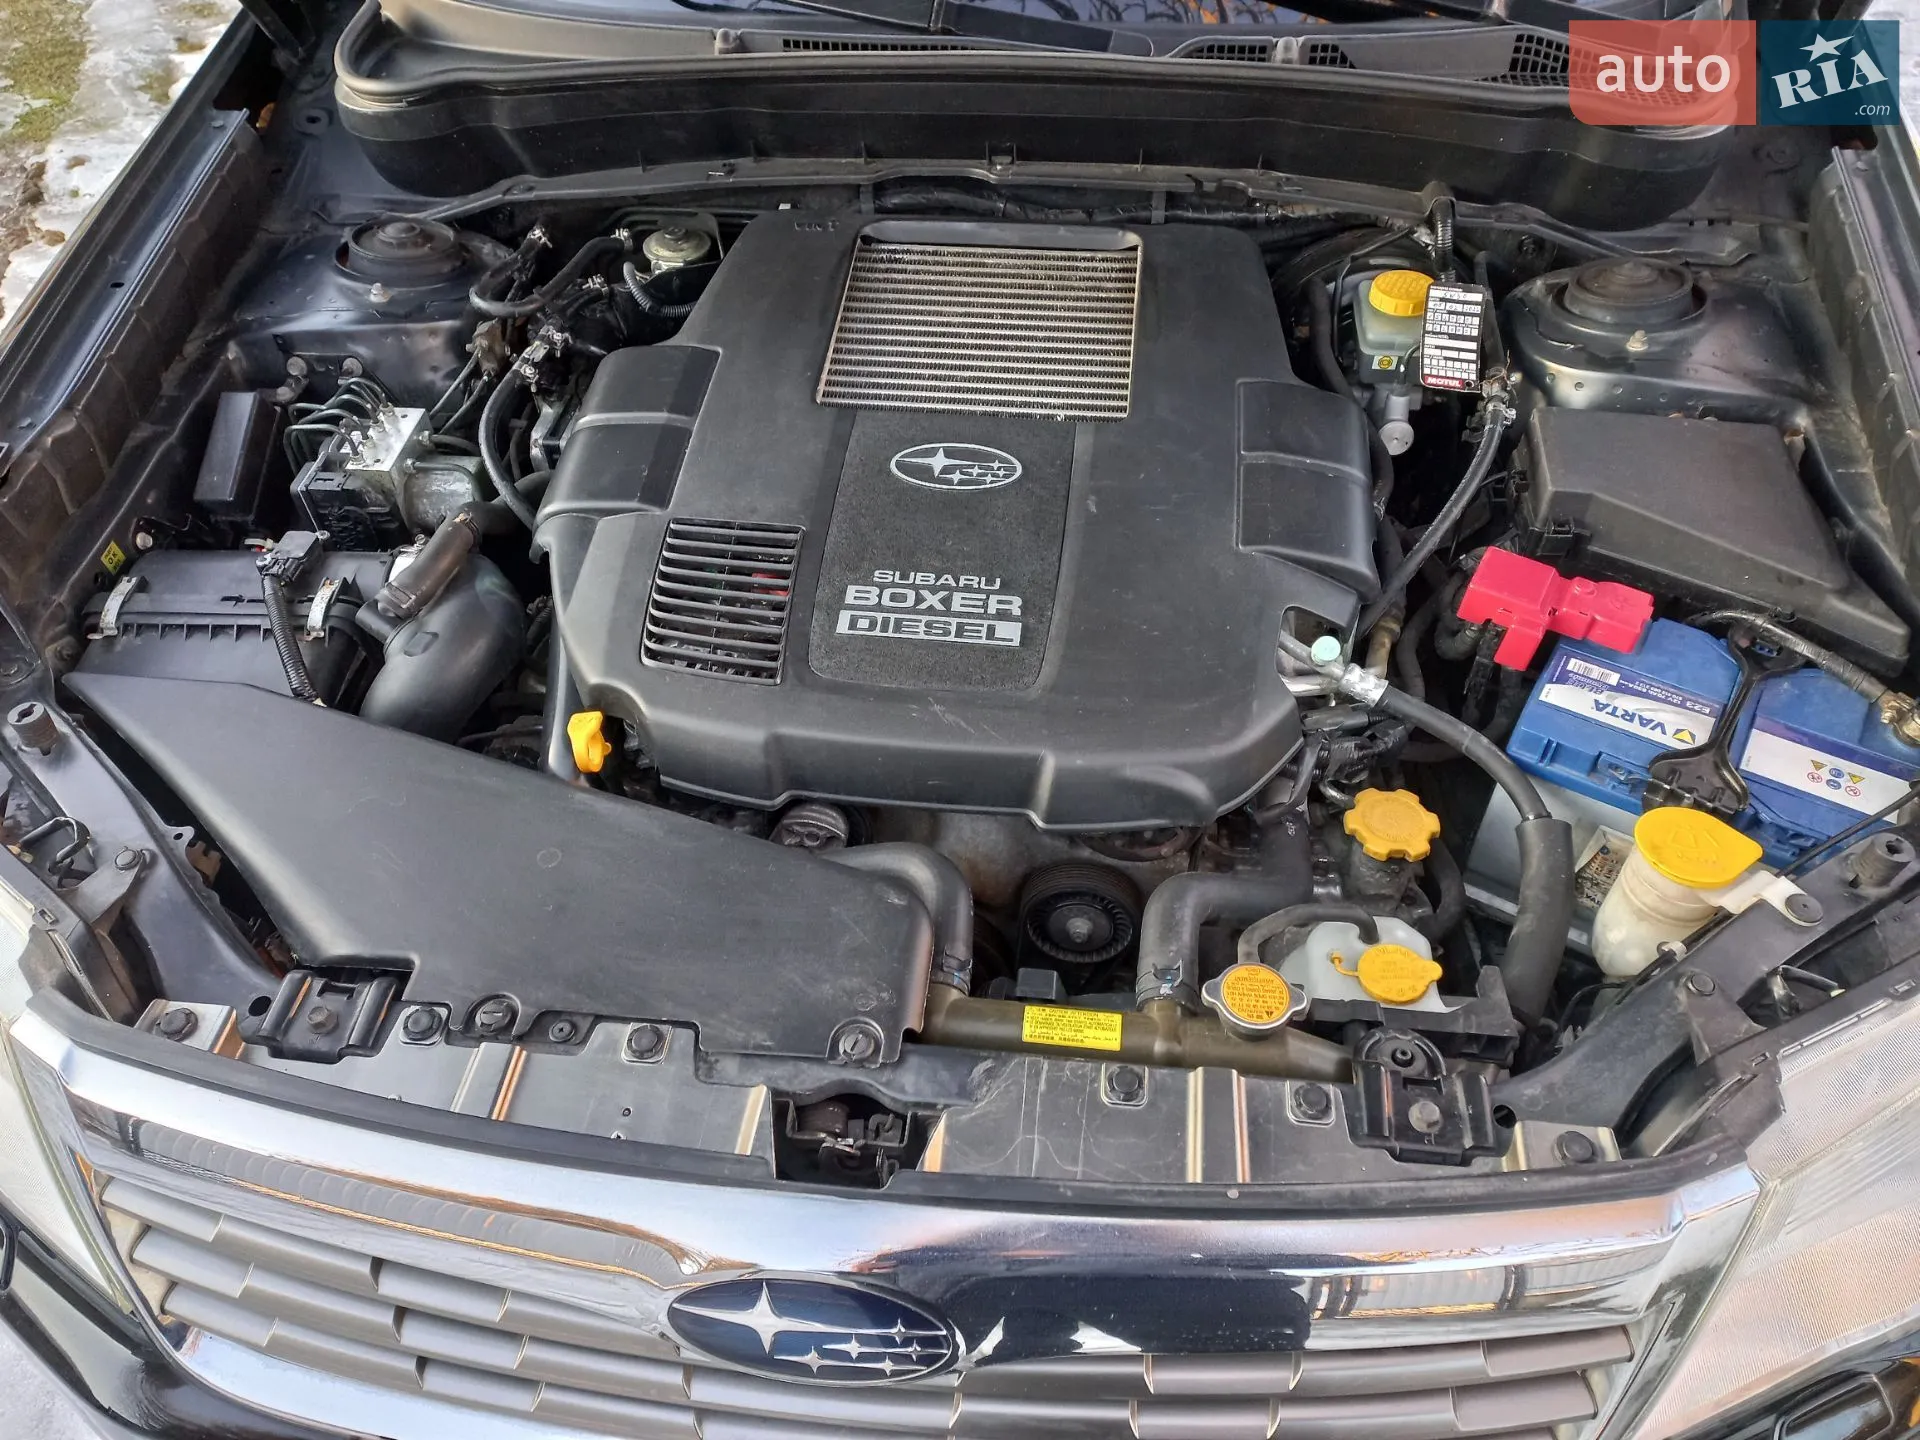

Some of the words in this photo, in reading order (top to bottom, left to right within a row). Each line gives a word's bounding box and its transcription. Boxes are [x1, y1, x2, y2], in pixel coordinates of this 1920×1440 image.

[1427, 376, 1461, 387] MOTUL
[873, 570, 1001, 590] SUBARU
[845, 585, 1023, 616] BOXER
[847, 613, 1014, 643] DIESEL
[1594, 698, 1667, 736] VARTA
[1685, 700, 1711, 714] E23
